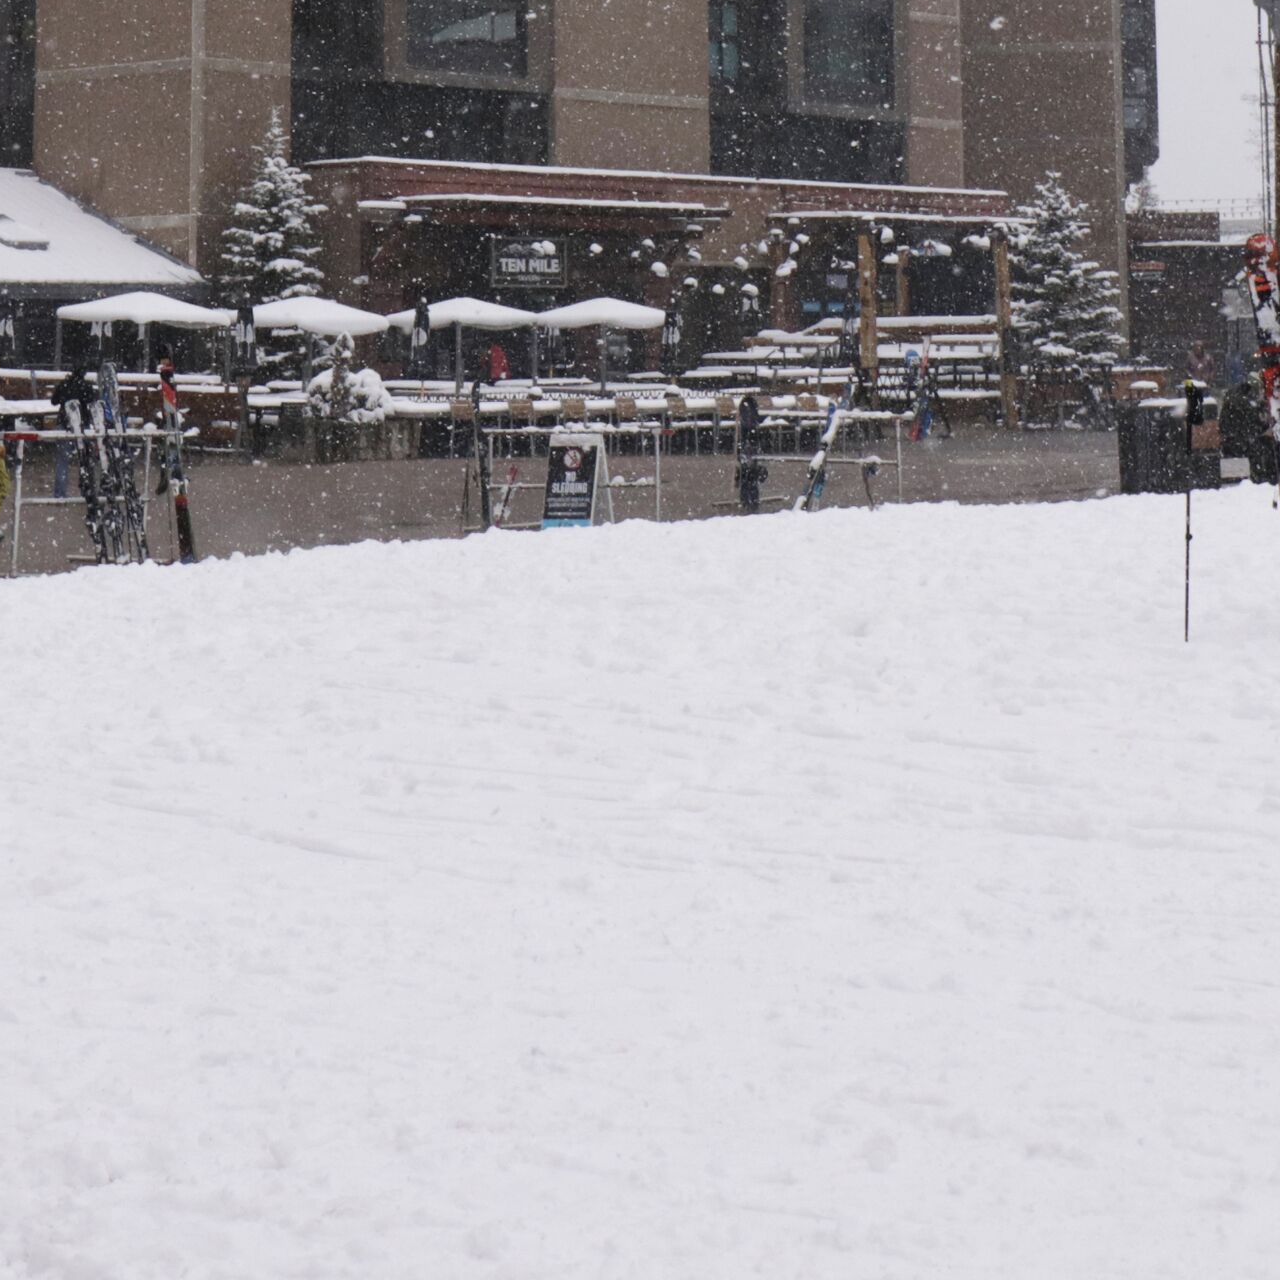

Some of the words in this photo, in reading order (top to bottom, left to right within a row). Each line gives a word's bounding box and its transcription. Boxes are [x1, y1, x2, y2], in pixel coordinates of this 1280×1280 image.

[499, 257, 526, 273] TEN
[528, 258, 560, 273] MILE
[551, 482, 588, 494] SLEDDING
